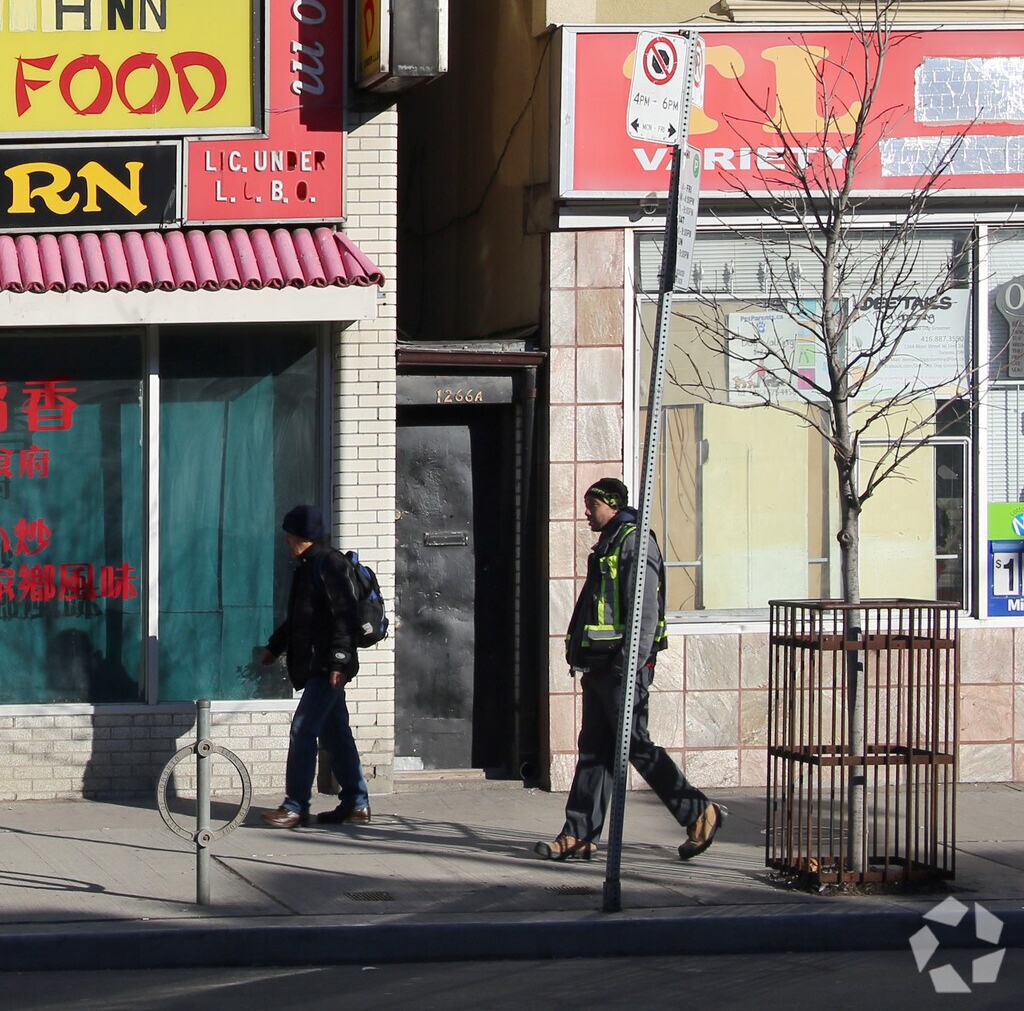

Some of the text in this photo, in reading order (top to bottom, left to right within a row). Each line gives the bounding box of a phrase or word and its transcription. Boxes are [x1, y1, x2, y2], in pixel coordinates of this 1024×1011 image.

[15, 50, 228, 117] FOOD
[633, 92, 679, 111] 4PM 6PM
[254, 150, 326, 172] UNDER
[633, 147, 851, 171] VRIETY
[435, 389, 483, 403] 1266A
